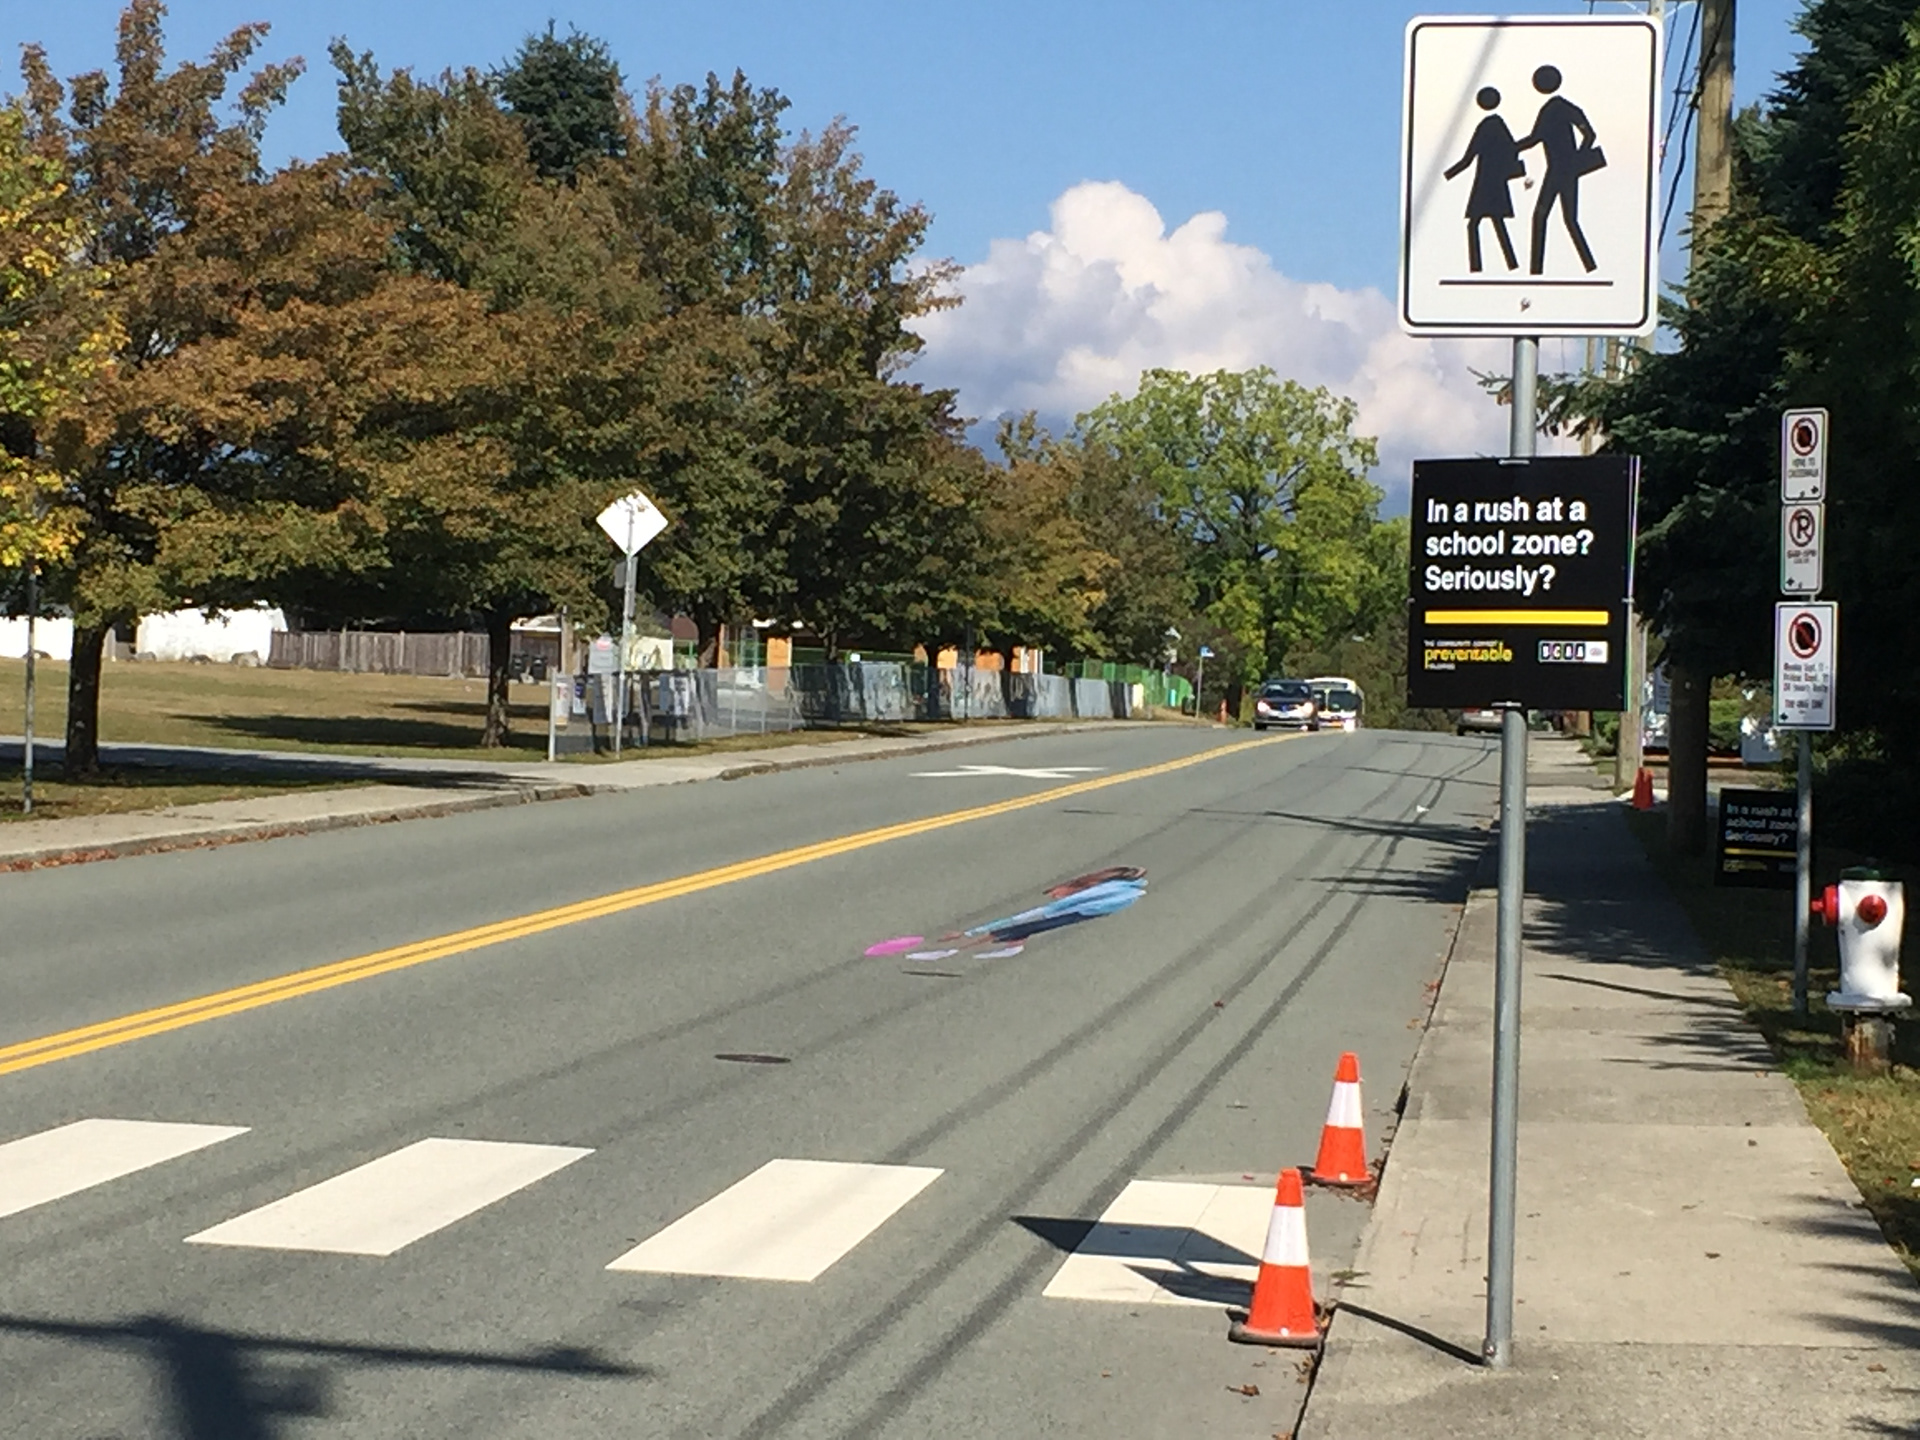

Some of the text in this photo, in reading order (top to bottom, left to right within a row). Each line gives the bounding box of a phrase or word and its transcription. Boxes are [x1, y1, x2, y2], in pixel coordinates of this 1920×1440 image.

[1427, 495, 1586, 523] In a rush at a
[1426, 529, 1595, 556] school zone?
[1425, 564, 1556, 597] Seriously?
[1424, 642, 1513, 670] preventable
[1726, 803, 1738, 815] In
[1741, 806, 1749, 815] a
[1780, 807, 1793, 817] at
[1725, 829, 1789, 846] Seriously?
[1726, 817, 1798, 831] school zone
